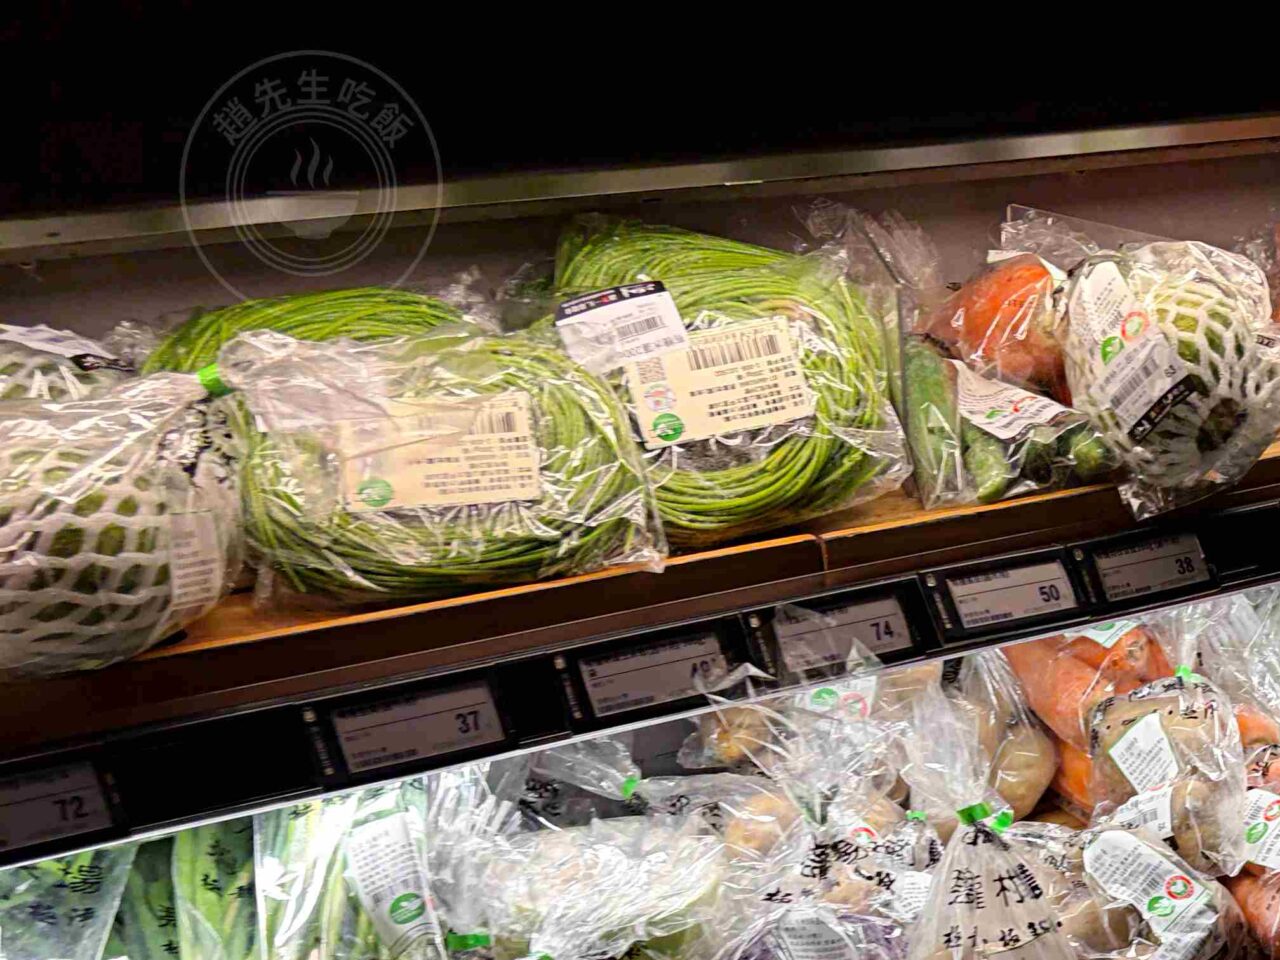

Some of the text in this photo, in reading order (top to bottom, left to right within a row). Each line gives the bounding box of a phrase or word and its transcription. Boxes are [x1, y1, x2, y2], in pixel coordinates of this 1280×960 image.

[1174, 556, 1196, 577] 38
[1036, 584, 1061, 604] 50
[868, 620, 895, 642] 74
[454, 709, 482, 735] 37
[53, 796, 89, 821] 72
